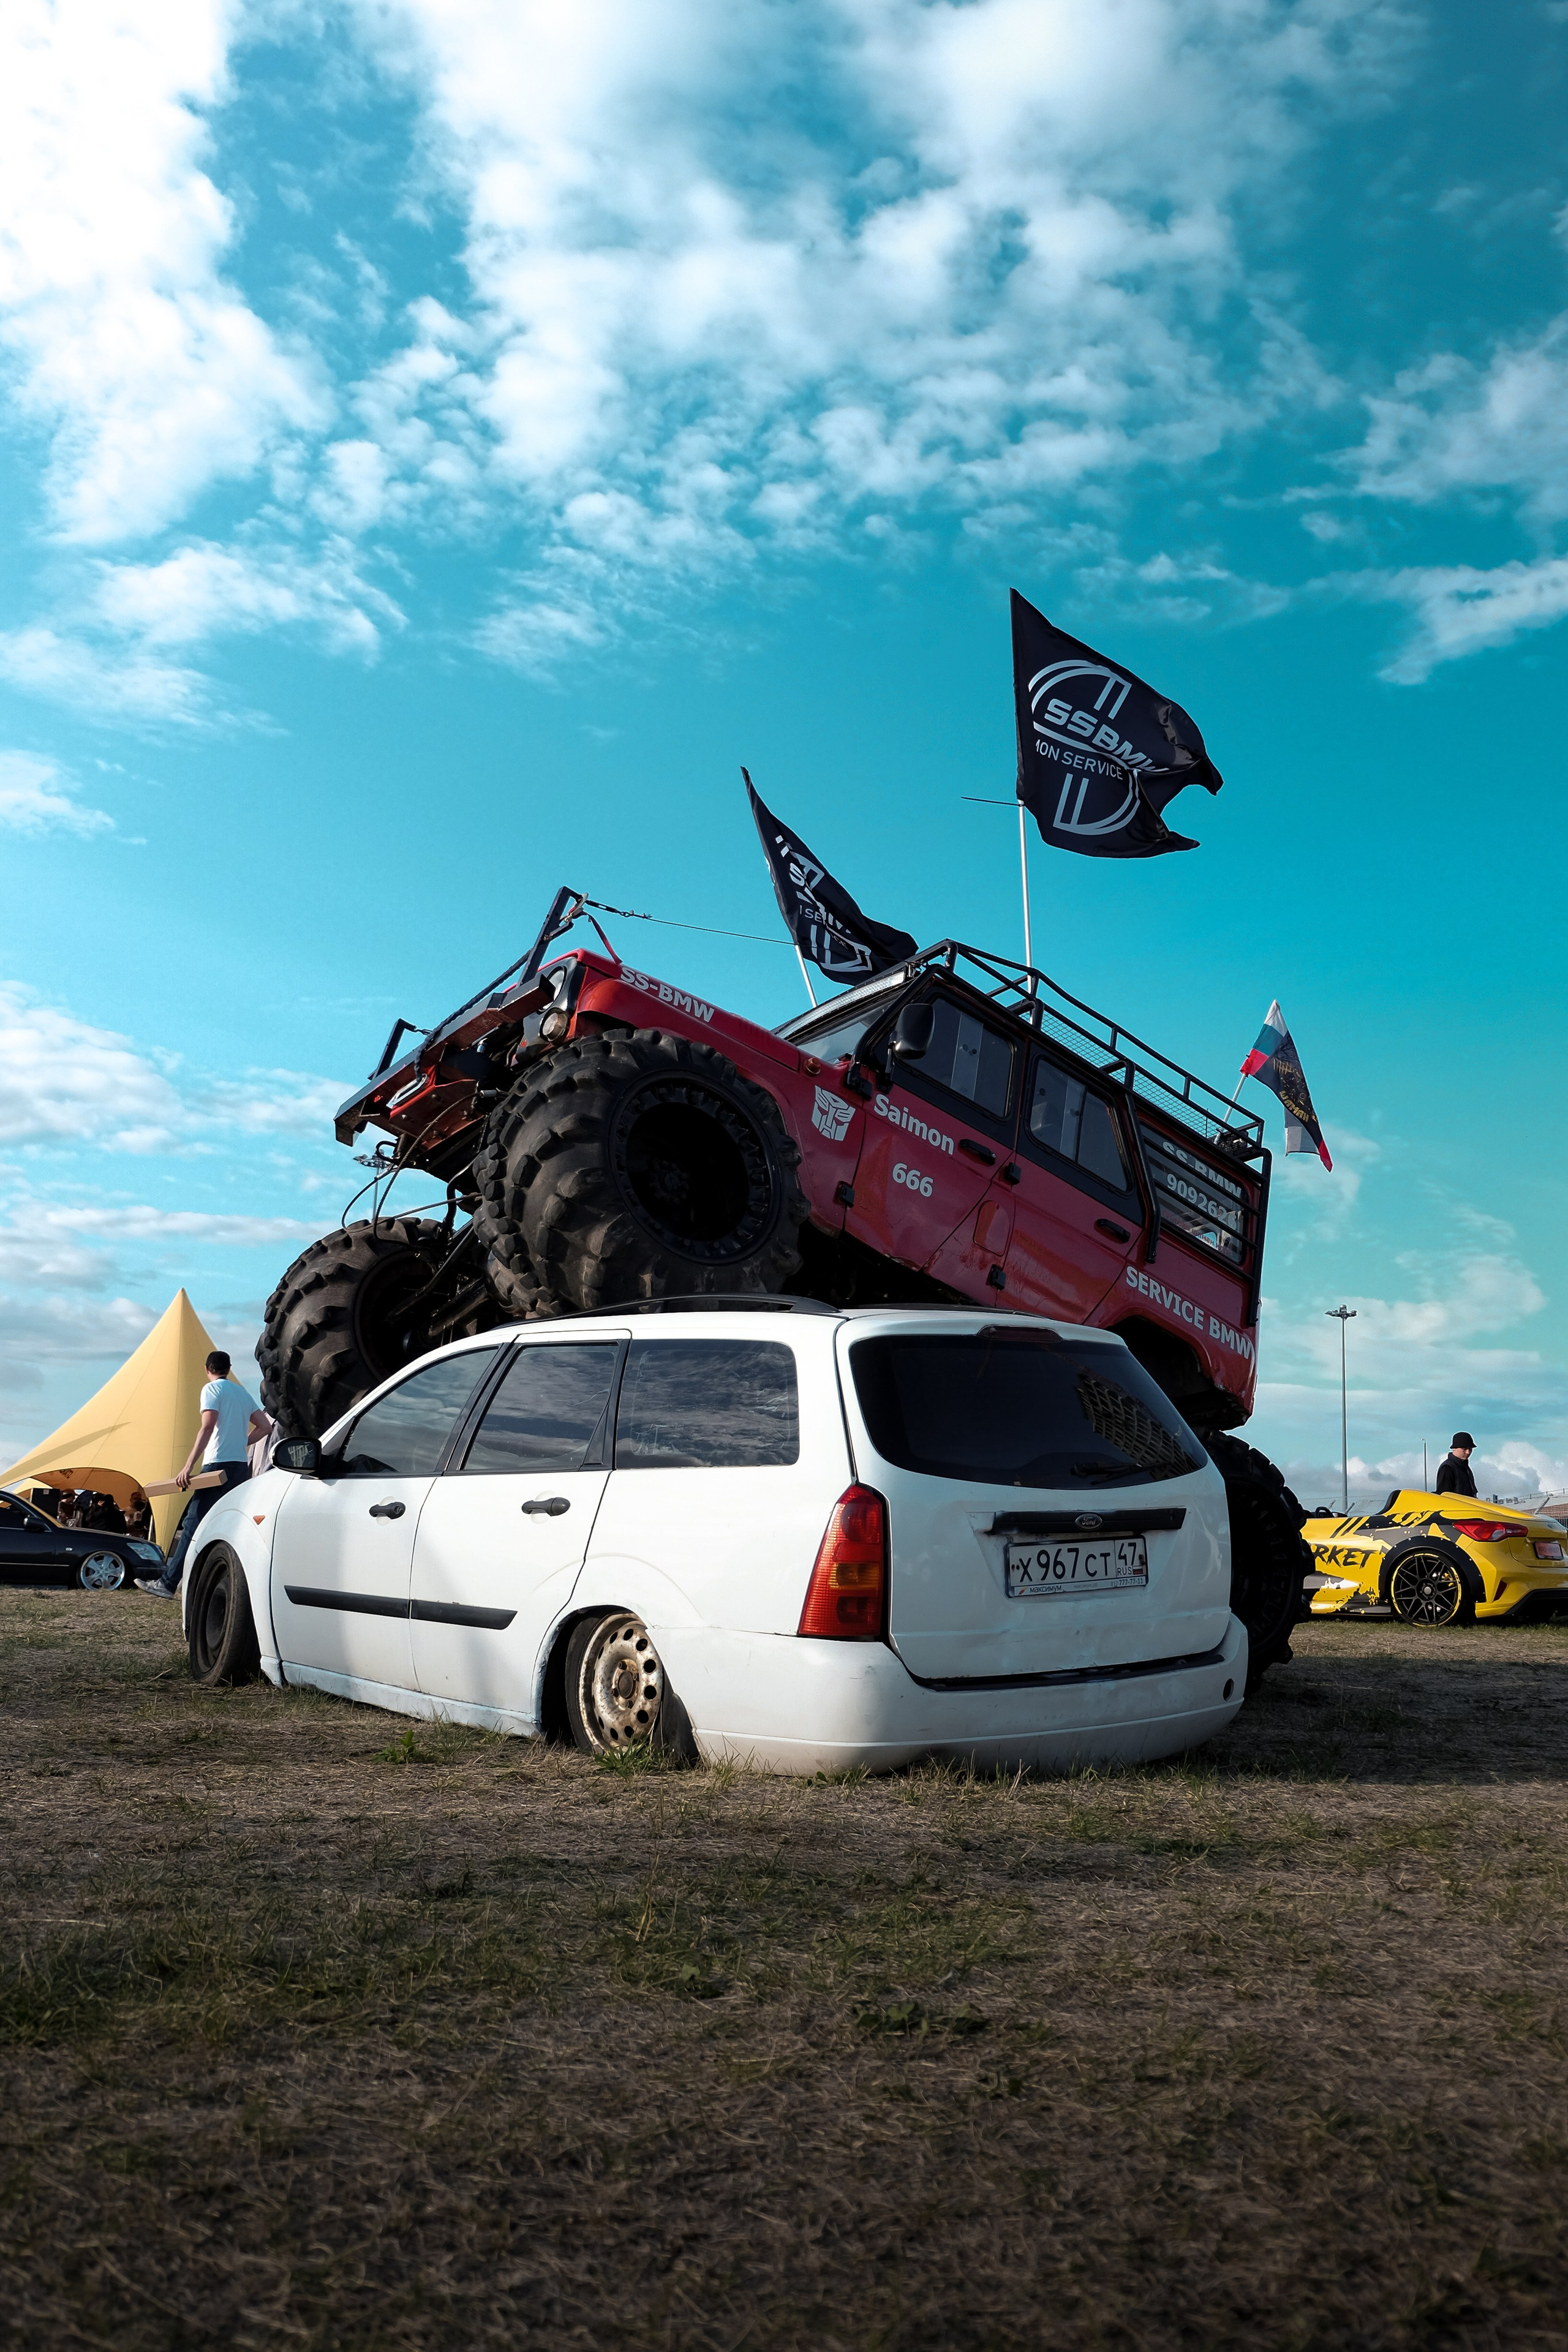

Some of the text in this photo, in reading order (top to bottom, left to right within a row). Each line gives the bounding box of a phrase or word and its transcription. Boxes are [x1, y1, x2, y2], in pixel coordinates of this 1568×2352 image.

[1061, 752, 1123, 780] SERVICE
[620, 967, 715, 1023] SS-BMW
[874, 1094, 955, 1155] Saimon
[892, 1163, 934, 1197] 666
[1126, 1266, 1251, 1360] SERVICE BMW
[1082, 1517, 1096, 1525] Ford
[1118, 1542, 1137, 1566] 47
[1117, 1567, 1132, 1575] RUS
